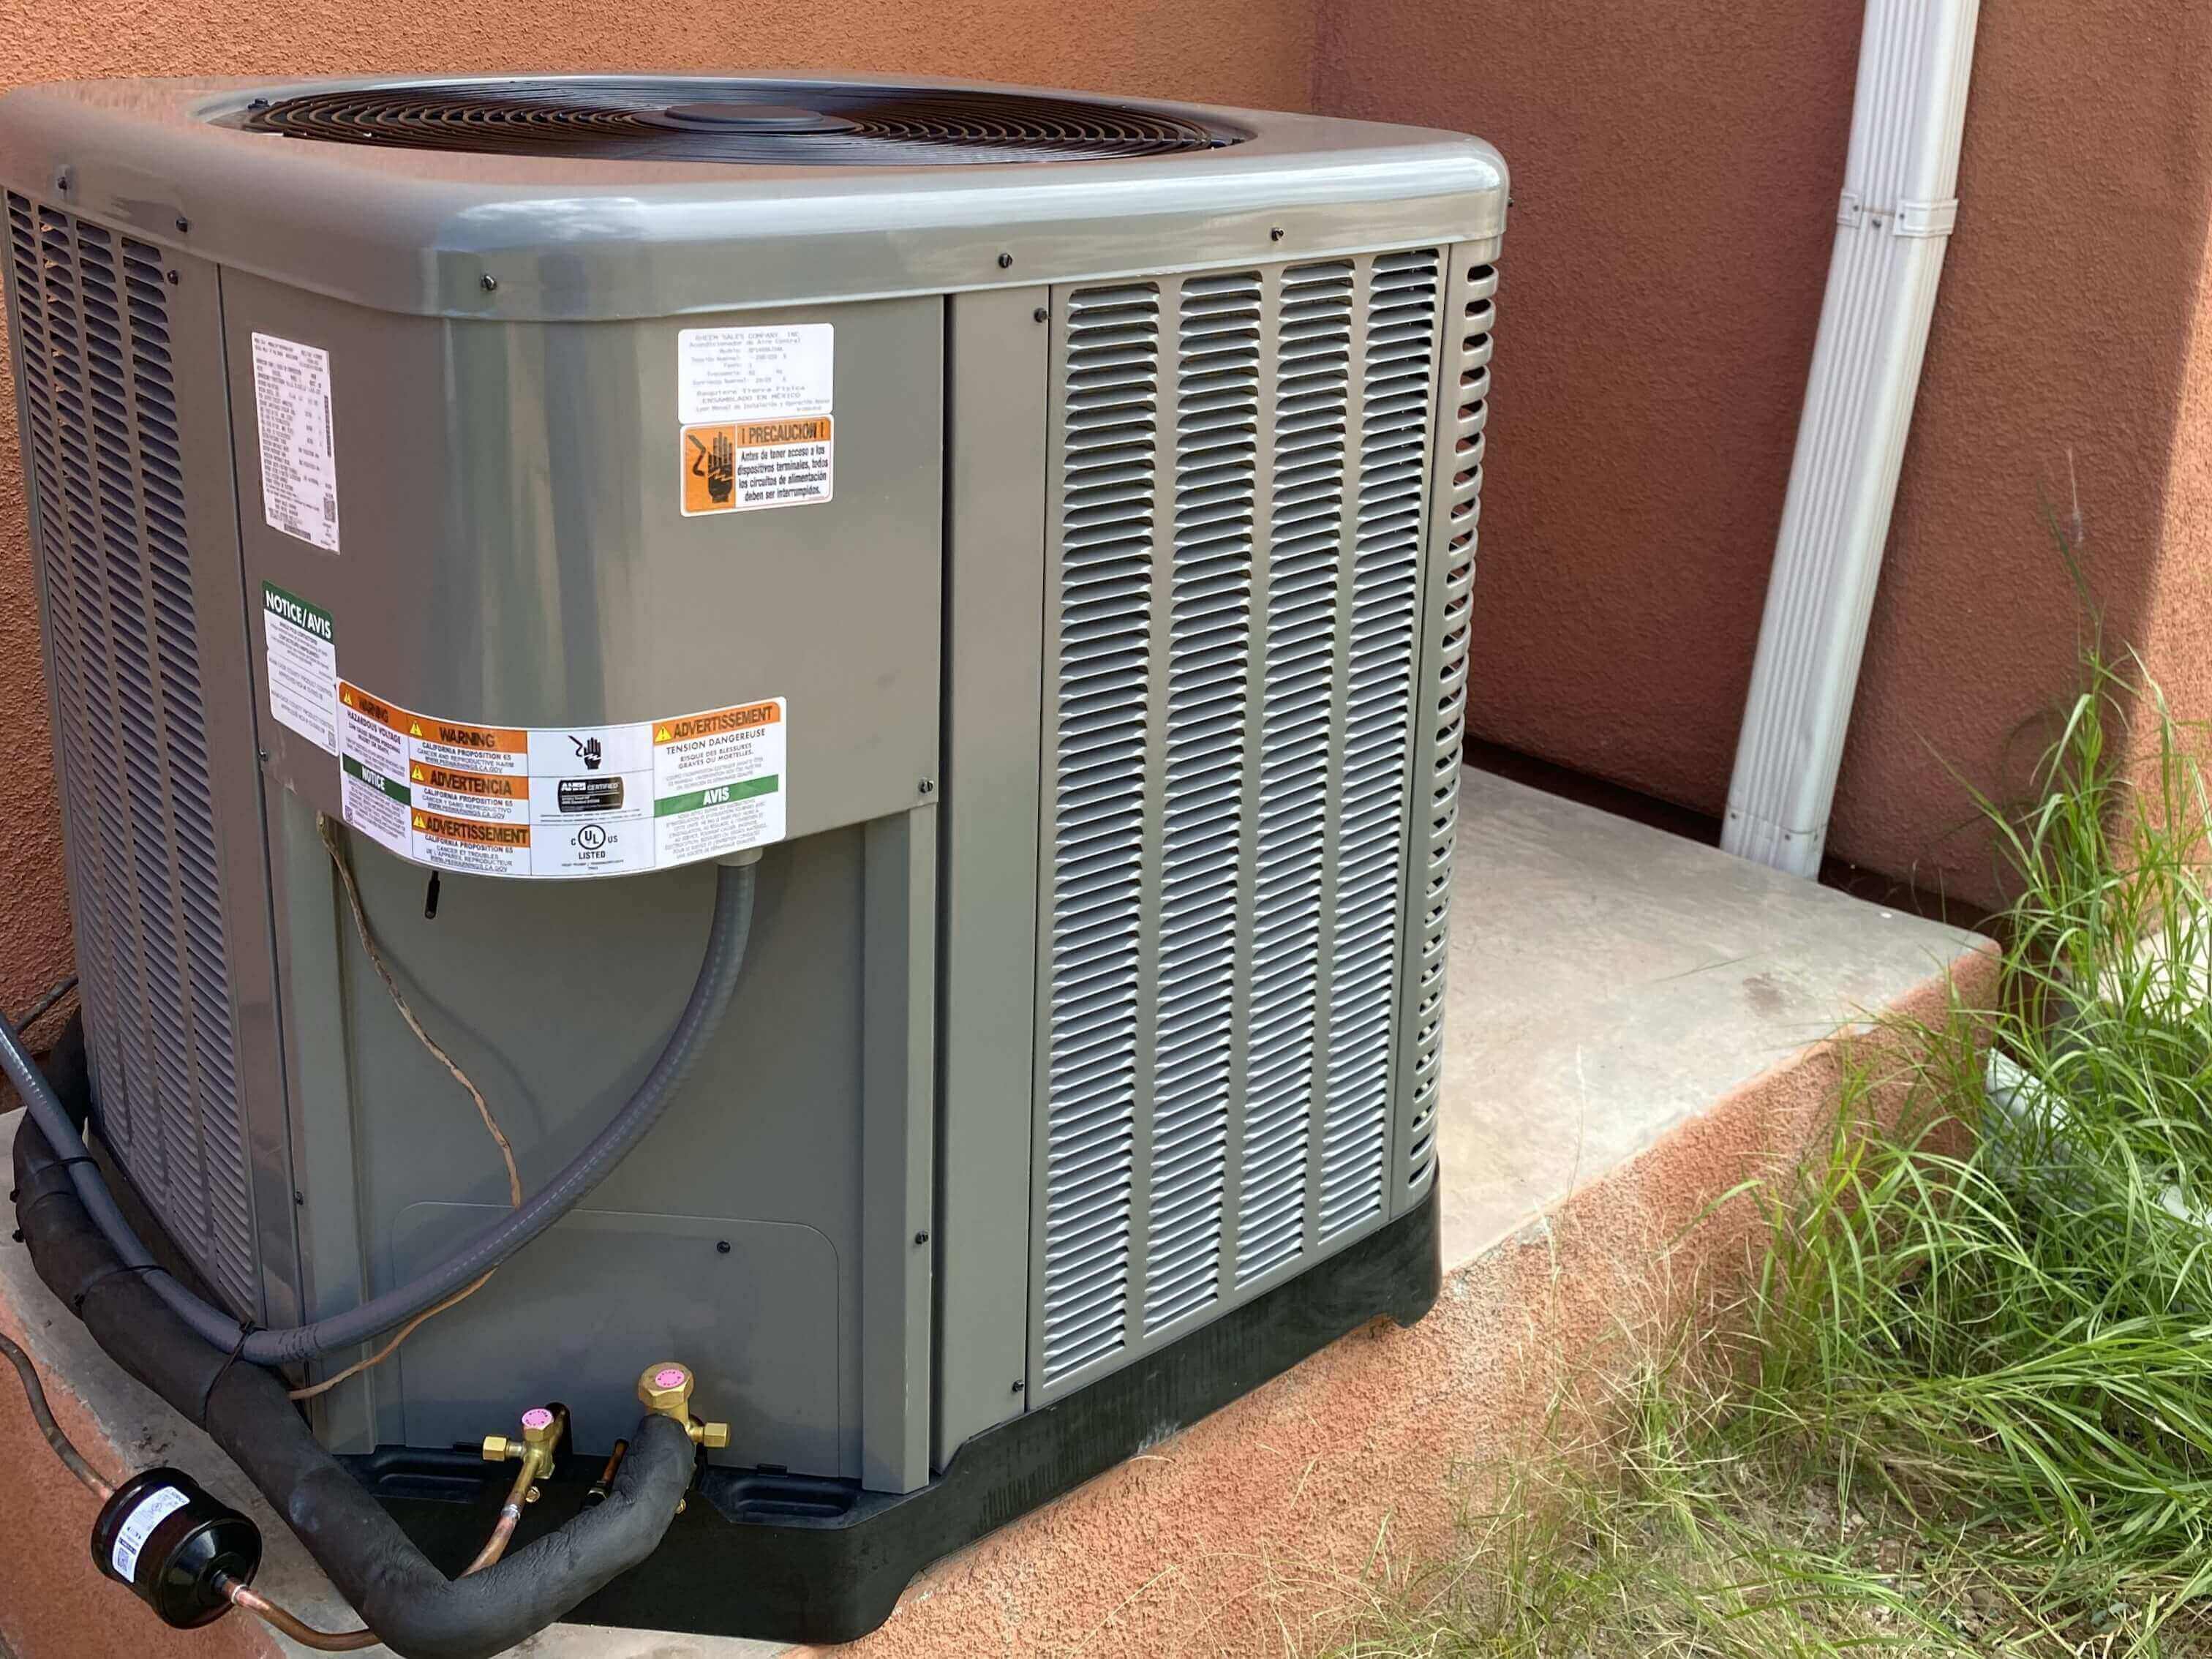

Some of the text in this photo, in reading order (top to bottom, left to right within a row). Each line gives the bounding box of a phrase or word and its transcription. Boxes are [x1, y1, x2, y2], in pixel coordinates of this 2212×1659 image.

[702, 395, 753, 405] ENSAMBLADO
[741, 445, 825, 462] Antes de tener acceso a los
[737, 457, 828, 477] dispositivos terminales, todos
[739, 478, 748, 489] los
[750, 475, 777, 488] circuitos
[779, 474, 786, 485] de
[745, 489, 764, 502] deben
[766, 491, 775, 500] ser
[347, 709, 377, 732] HAZARDOUS
[379, 727, 401, 745] VOLTAGE
[673, 705, 772, 738] ADVERTISSEMENT
[439, 726, 495, 748] WARNING
[666, 729, 766, 755] TENSION DANGEREUSE
[417, 748, 438, 758] CANCER
[450, 755, 495, 767] REPRODUCTIVE
[422, 742, 456, 755] CALIFORNIA
[457, 748, 502, 759] PROPOSITION
[678, 759, 704, 769] GRAVES
[718, 749, 754, 761] MORTELLES.
[680, 753, 704, 762] RISQUE
[719, 742, 752, 754] BLESSURES
[361, 765, 385, 791] NOTICE
[431, 770, 513, 795] ADVERTENCIA
[424, 788, 458, 801] CALIFORNIA
[459, 794, 503, 806] PROPOSITION
[702, 786, 730, 806] AVIS
[465, 804, 512, 814] REPRODUCTIVO
[426, 816, 527, 844] ADVERTISSEMENT
[584, 830, 600, 845] UL
[424, 835, 458, 848] CALIFORNIA
[459, 842, 504, 853] PROPOSITION
[464, 856, 513, 867] REPRODUCTEUR
[467, 850, 499, 860] TROUBLES
[578, 851, 606, 859] LISTED
